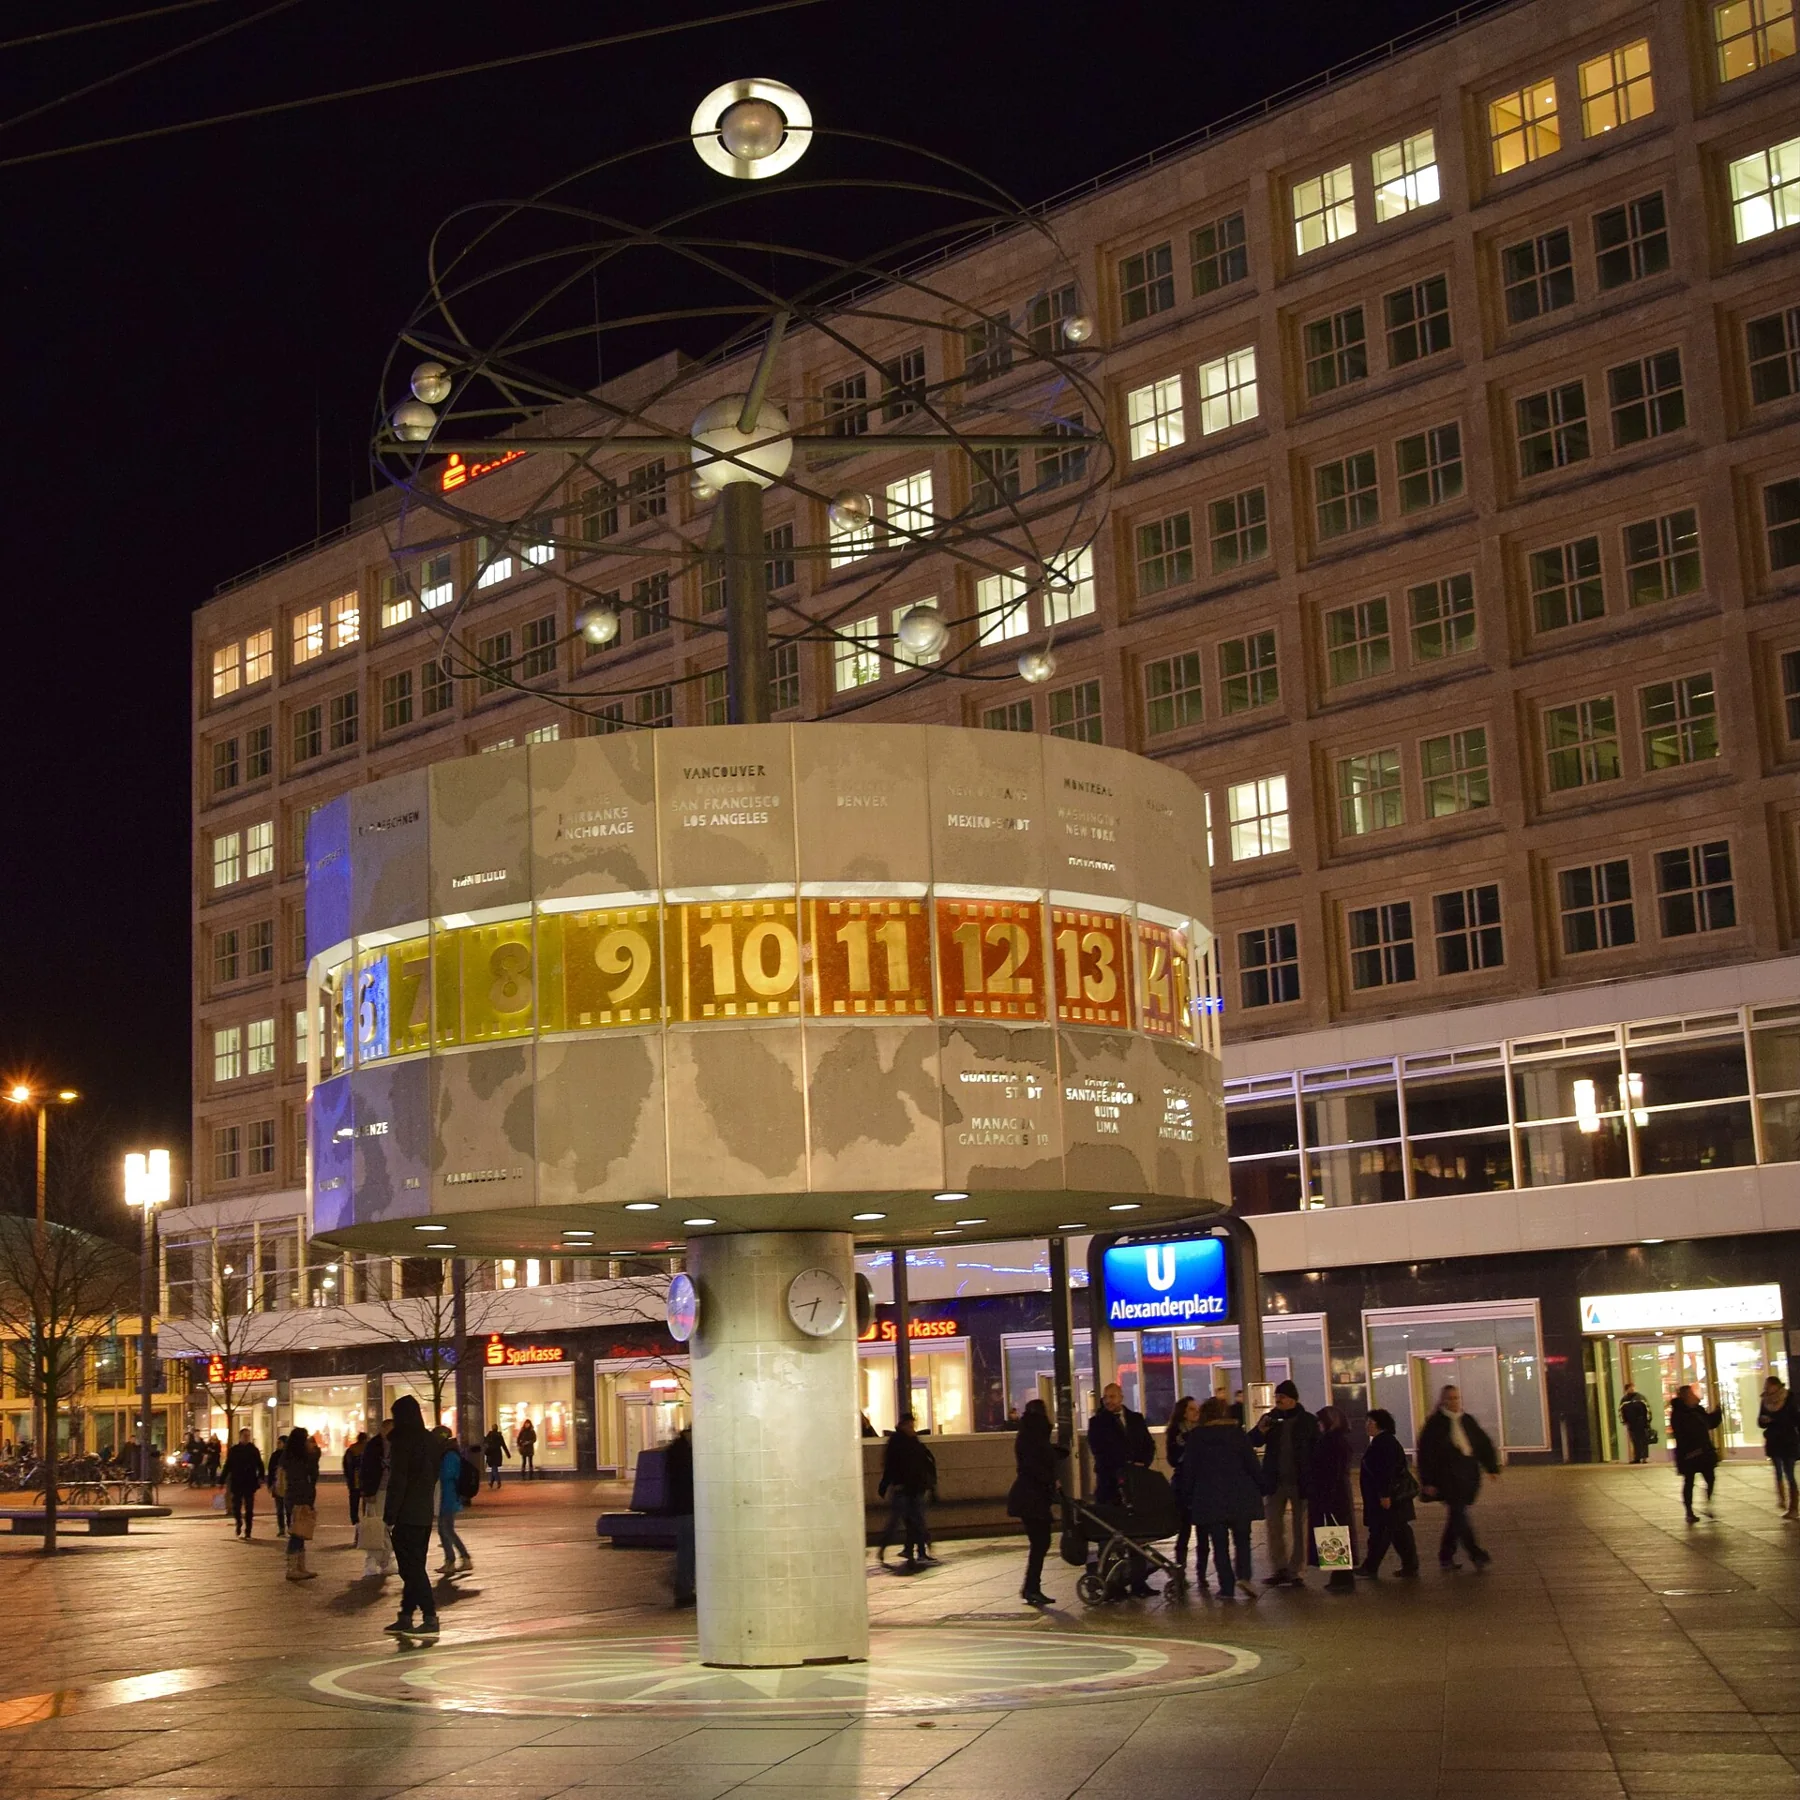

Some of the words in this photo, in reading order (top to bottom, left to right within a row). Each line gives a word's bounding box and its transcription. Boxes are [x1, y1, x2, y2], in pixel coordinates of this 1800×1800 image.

[683, 764, 767, 780] VANCOUVER
[1063, 777, 1114, 797] MONTREAL
[671, 800, 699, 812] SAN
[704, 795, 780, 810] FRANCISCO
[836, 795, 889, 808] DENVER
[683, 814, 706, 827] LOS
[709, 811, 769, 826] ANGELES
[554, 821, 635, 842] ANCHORAGE
[1065, 824, 1088, 837] NEW
[489, 941, 533, 1015] 8
[594, 929, 652, 1004] 9
[700, 921, 800, 997] 10
[836, 920, 911, 993] 11
[952, 922, 1034, 995] 12
[1056, 930, 1117, 1003] 13
[1005, 1086, 1042, 1099] STDT
[1094, 1105, 1120, 1119] QUITO
[1096, 1120, 1119, 1134] LIMA
[1145, 1245, 1176, 1292] U
[1110, 1293, 1224, 1320] Alexanderplatz
[881, 1318, 956, 1342] Sprkasse
[506, 1346, 563, 1365] Sparkasse
